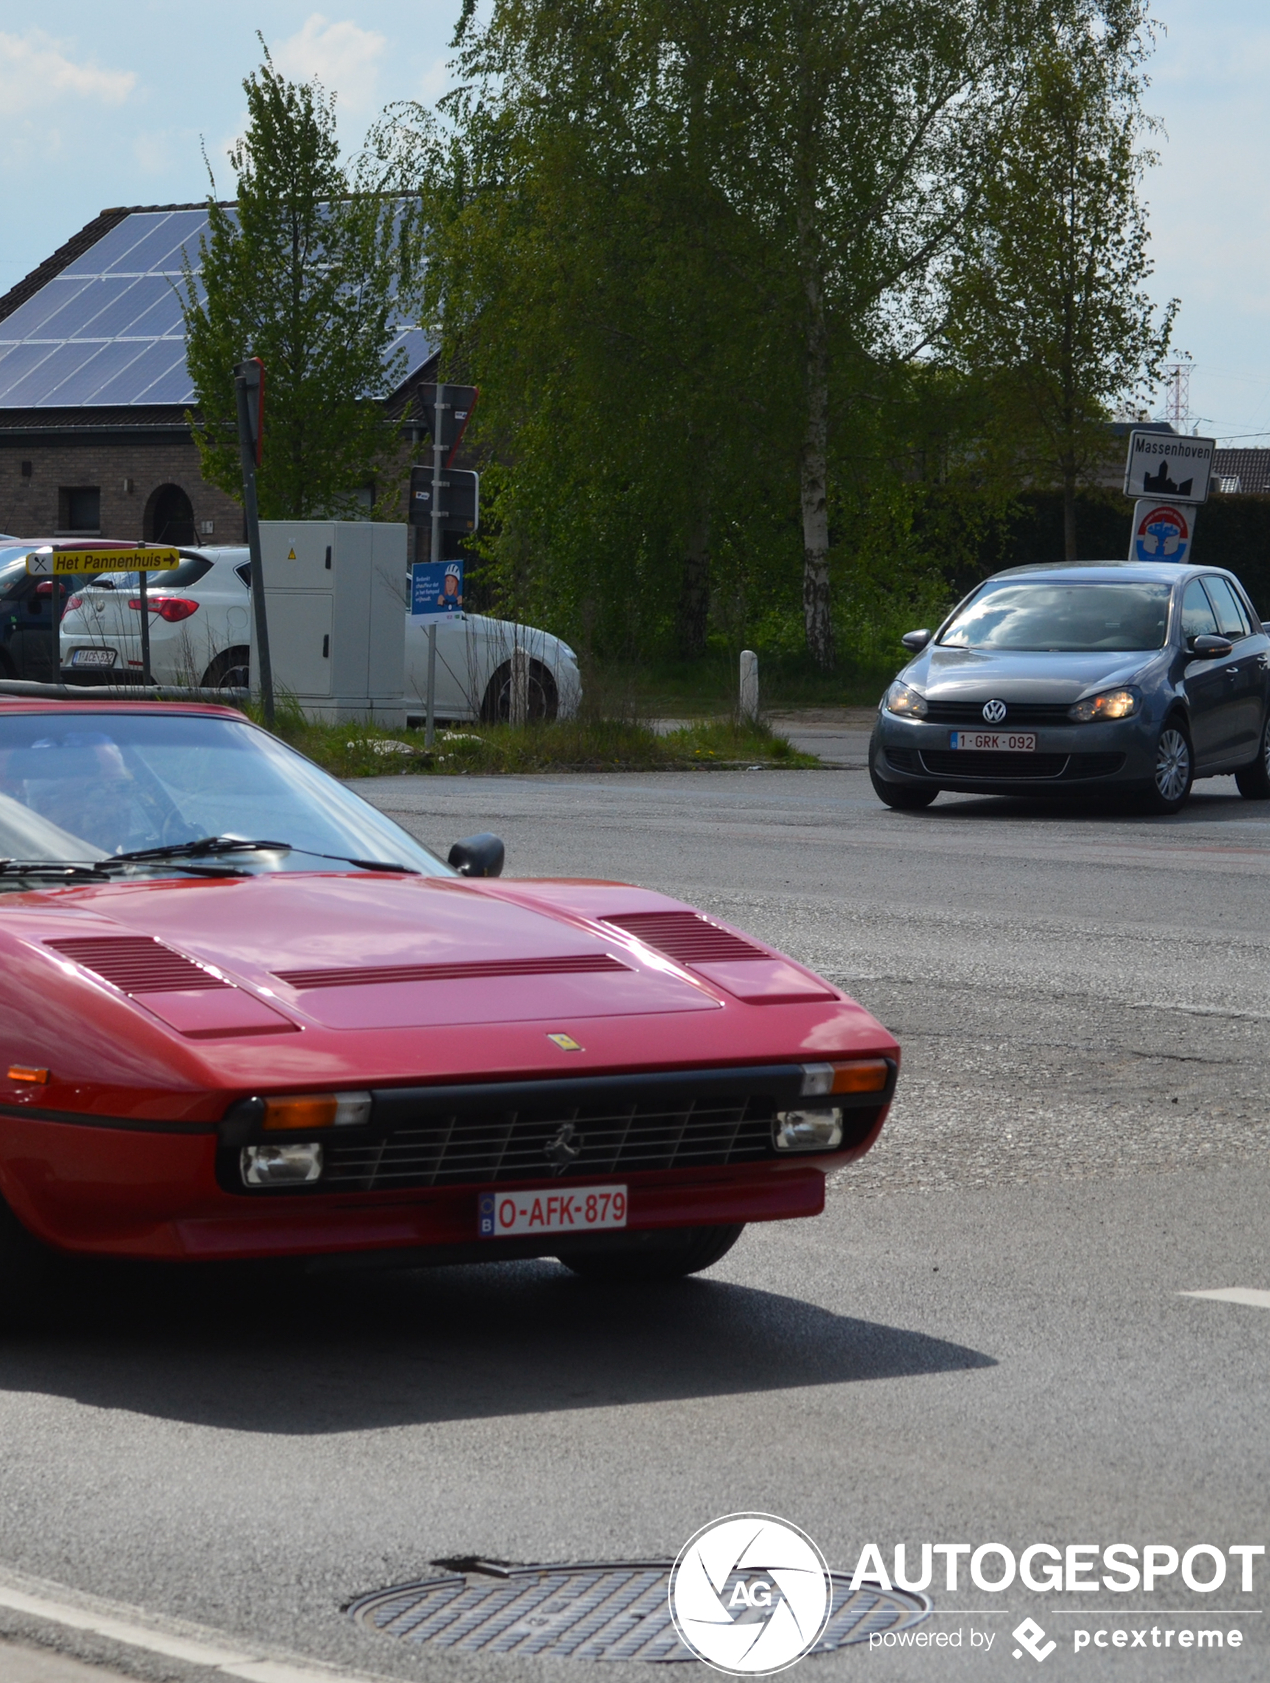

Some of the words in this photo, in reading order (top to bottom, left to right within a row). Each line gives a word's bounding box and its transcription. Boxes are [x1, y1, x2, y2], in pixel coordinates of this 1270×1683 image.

[1135, 438, 1210, 459] Massenhoven
[56, 556, 79, 570] Het
[84, 553, 161, 569] Pannenhuis
[482, 1218, 492, 1232] B
